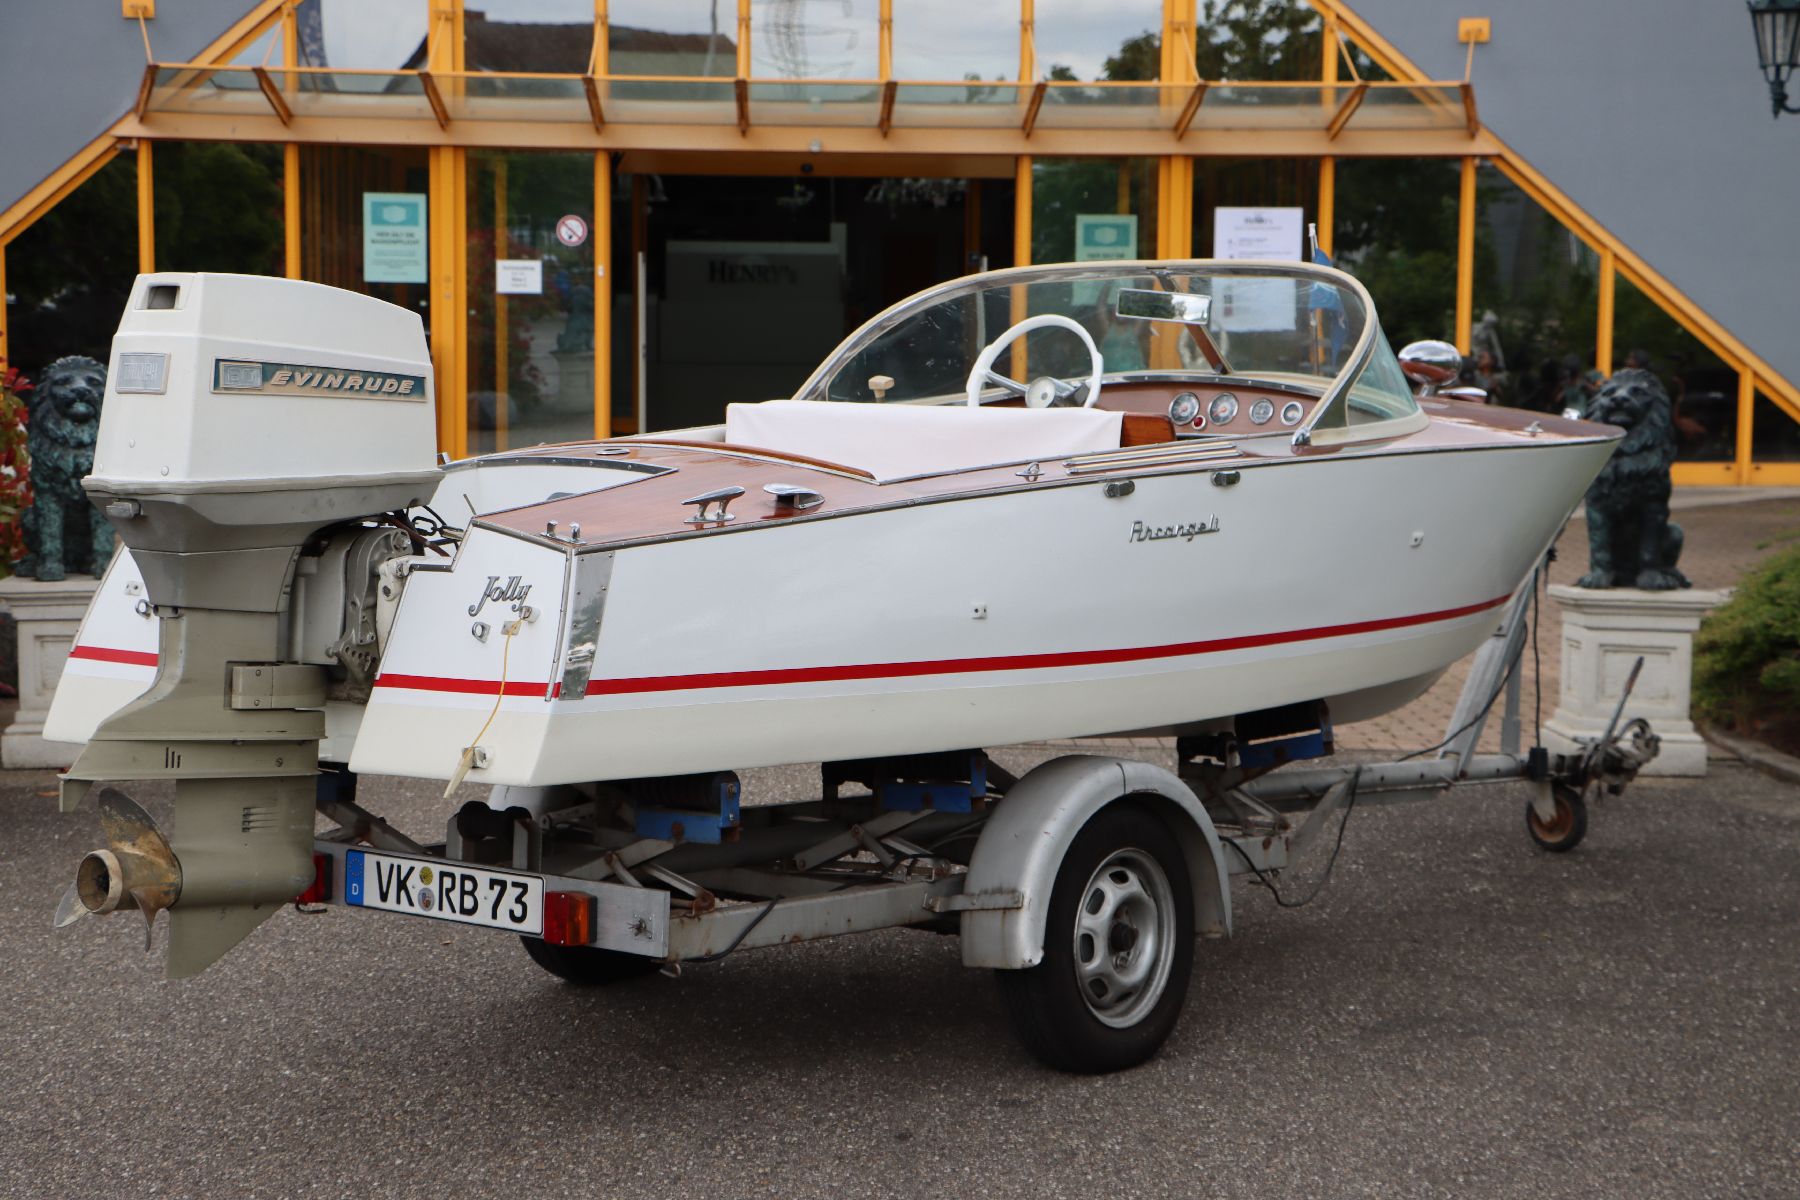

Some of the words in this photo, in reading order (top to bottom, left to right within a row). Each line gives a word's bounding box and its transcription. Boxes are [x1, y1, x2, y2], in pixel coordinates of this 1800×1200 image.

[270, 370, 415, 394] EVINRUDE
[468, 575, 533, 617] Jolly
[351, 883, 359, 895] D
[376, 861, 416, 907] VK
[438, 870, 479, 917] RB
[489, 878, 529, 924] 73
